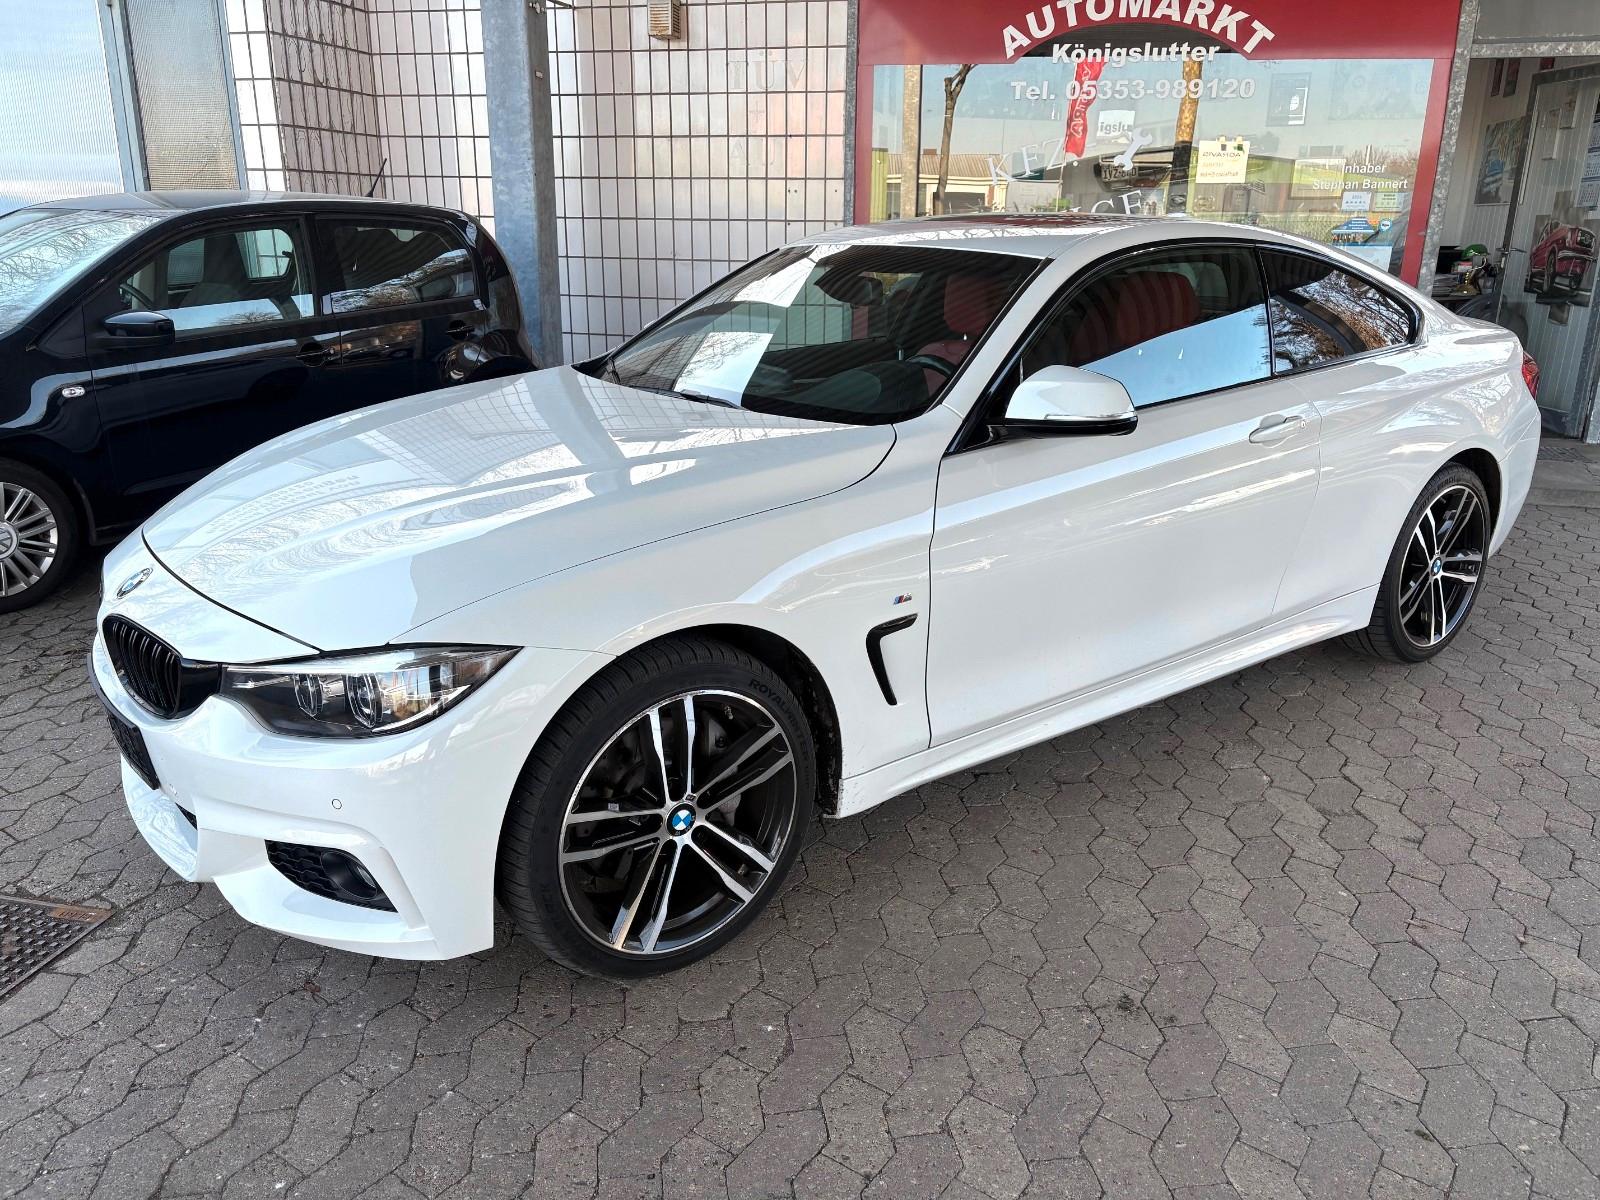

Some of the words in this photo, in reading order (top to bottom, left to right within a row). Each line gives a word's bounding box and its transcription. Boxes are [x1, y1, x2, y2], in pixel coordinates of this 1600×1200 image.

[1002, 0, 1276, 59] AUTOMARKT
[1052, 42, 1220, 68] Königslutter
[727, 50, 805, 91] TÜV
[1010, 80, 1055, 100] Tel.
[1066, 78, 1256, 101] 05353-989120
[1343, 162, 1387, 174] Inhaber
[1312, 179, 1358, 191] Stephan
[1362, 177, 1408, 189] Bannert
